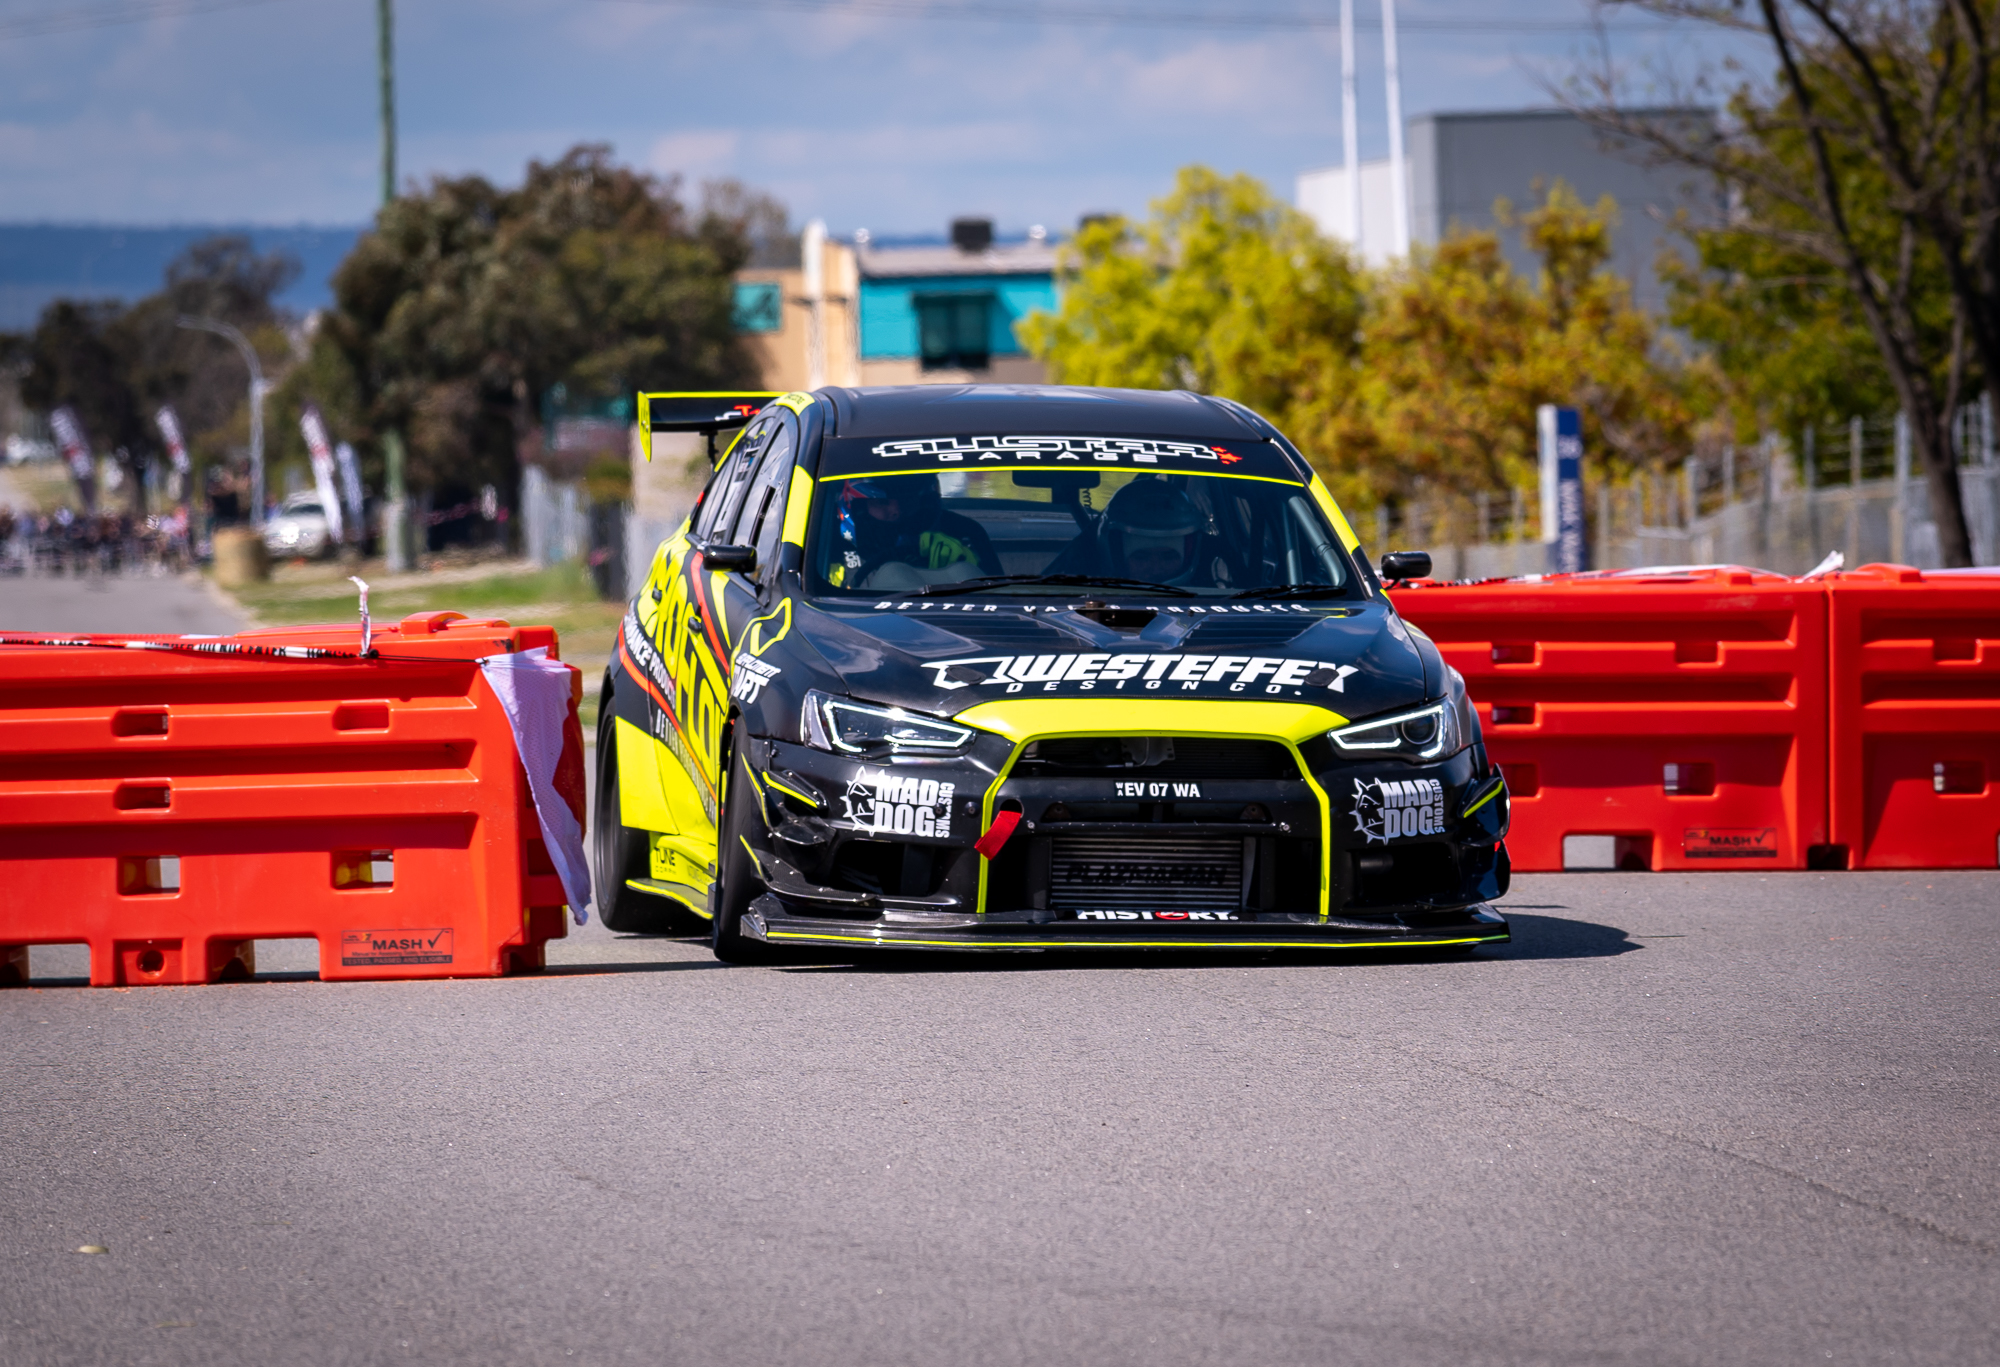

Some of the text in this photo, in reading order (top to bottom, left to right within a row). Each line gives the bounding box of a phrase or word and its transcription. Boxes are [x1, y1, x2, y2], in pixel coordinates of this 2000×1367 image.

[938, 451, 1158, 463] GARAGE
[874, 601, 998, 612] BETTER
[876, 776, 940, 807] MAD
[1124, 782, 1145, 797] EV
[1149, 782, 1169, 797] 07
[1172, 783, 1201, 798] WA
[1380, 779, 1433, 809] MAD
[1429, 779, 1445, 833] CUSTOMS
[874, 801, 936, 838] DOG
[1384, 806, 1435, 838] DOG
[1709, 836, 1751, 846] MASH
[372, 938, 422, 950] MASH
